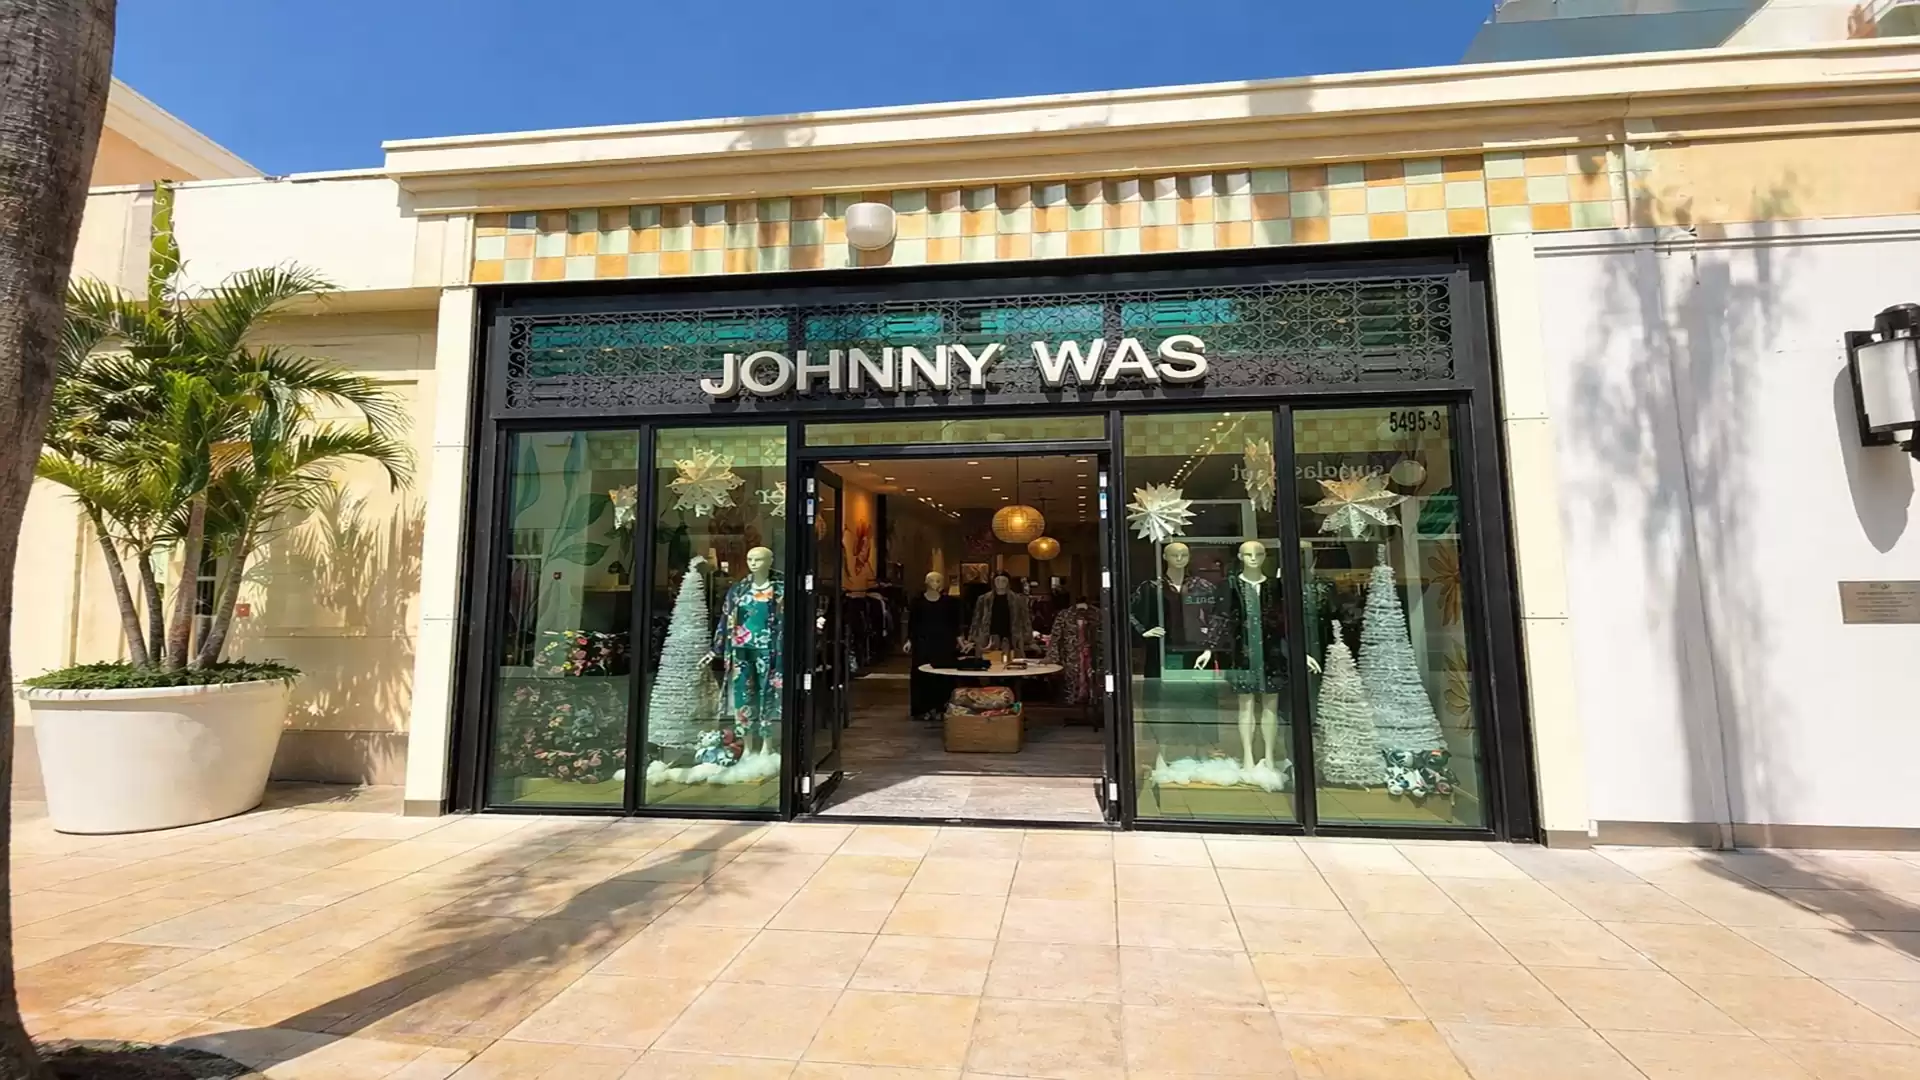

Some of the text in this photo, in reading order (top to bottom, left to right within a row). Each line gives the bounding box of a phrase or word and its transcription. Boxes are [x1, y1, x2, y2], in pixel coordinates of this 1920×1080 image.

[700, 334, 1209, 399] JOHNNY WAS
[1389, 410, 1441, 432] 5495-3
